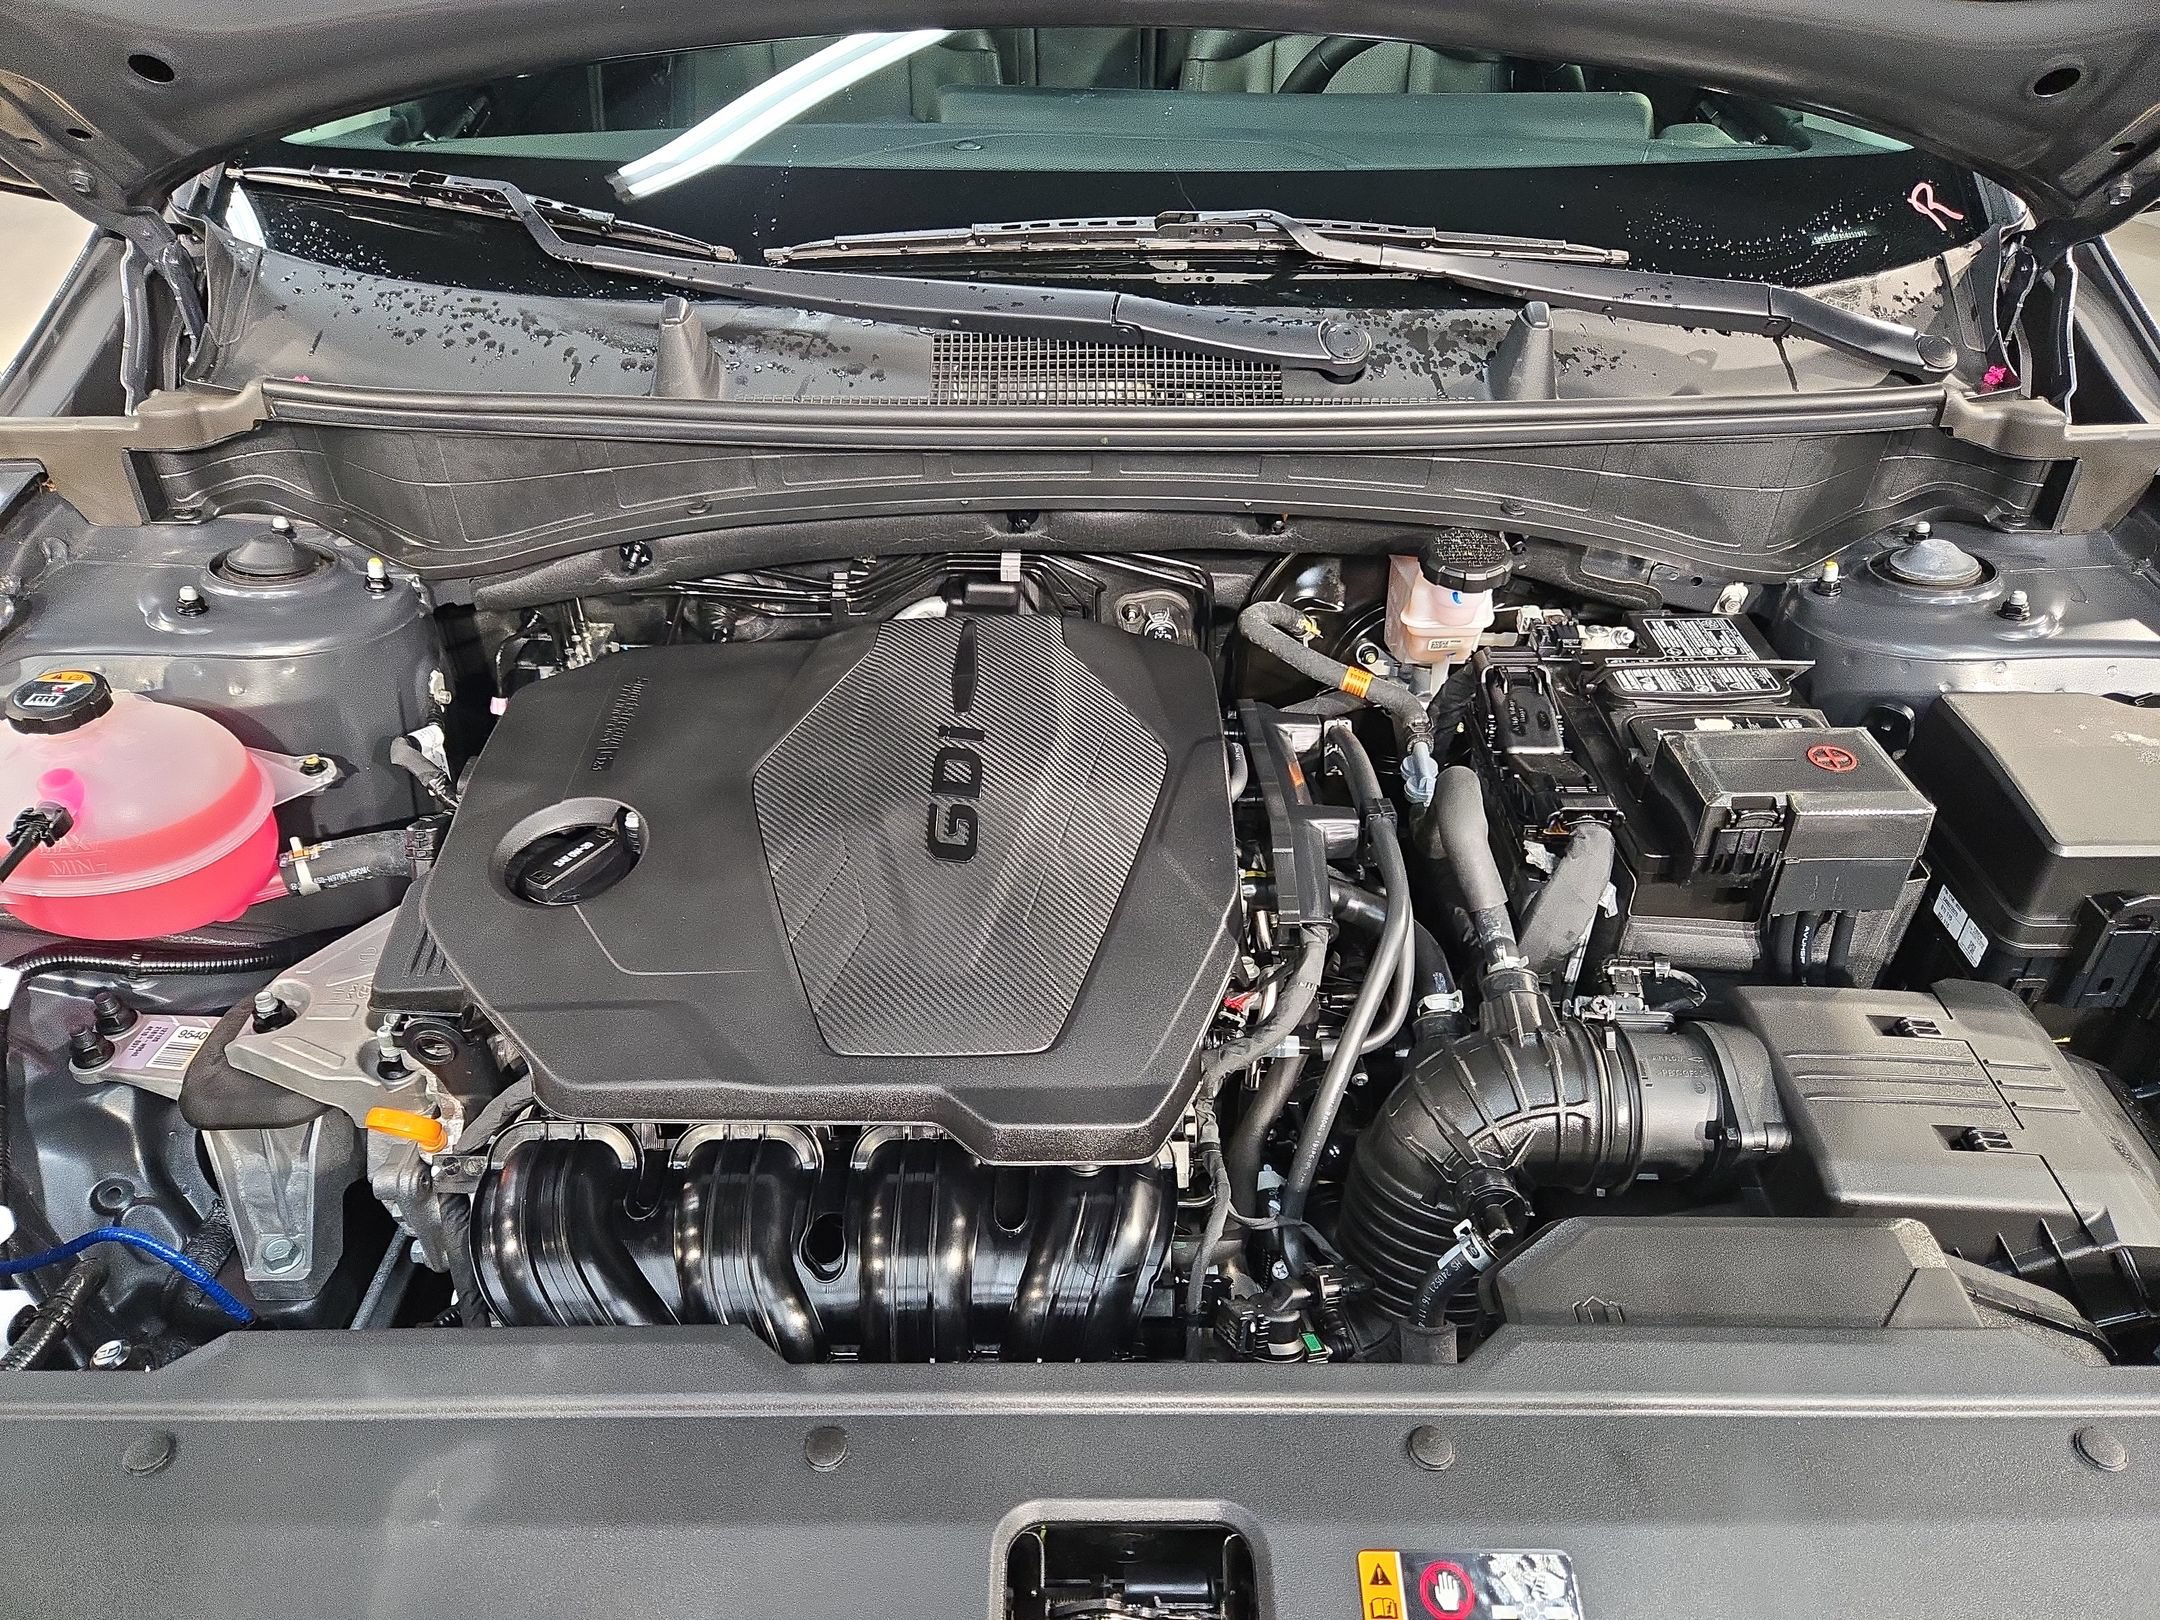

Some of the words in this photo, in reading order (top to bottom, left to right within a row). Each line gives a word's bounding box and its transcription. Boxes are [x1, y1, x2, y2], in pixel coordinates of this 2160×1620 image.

[49, 859, 96, 875] MIN
[178, 1029, 209, 1041] 9540
[1429, 1268, 1451, 1293] 240521
